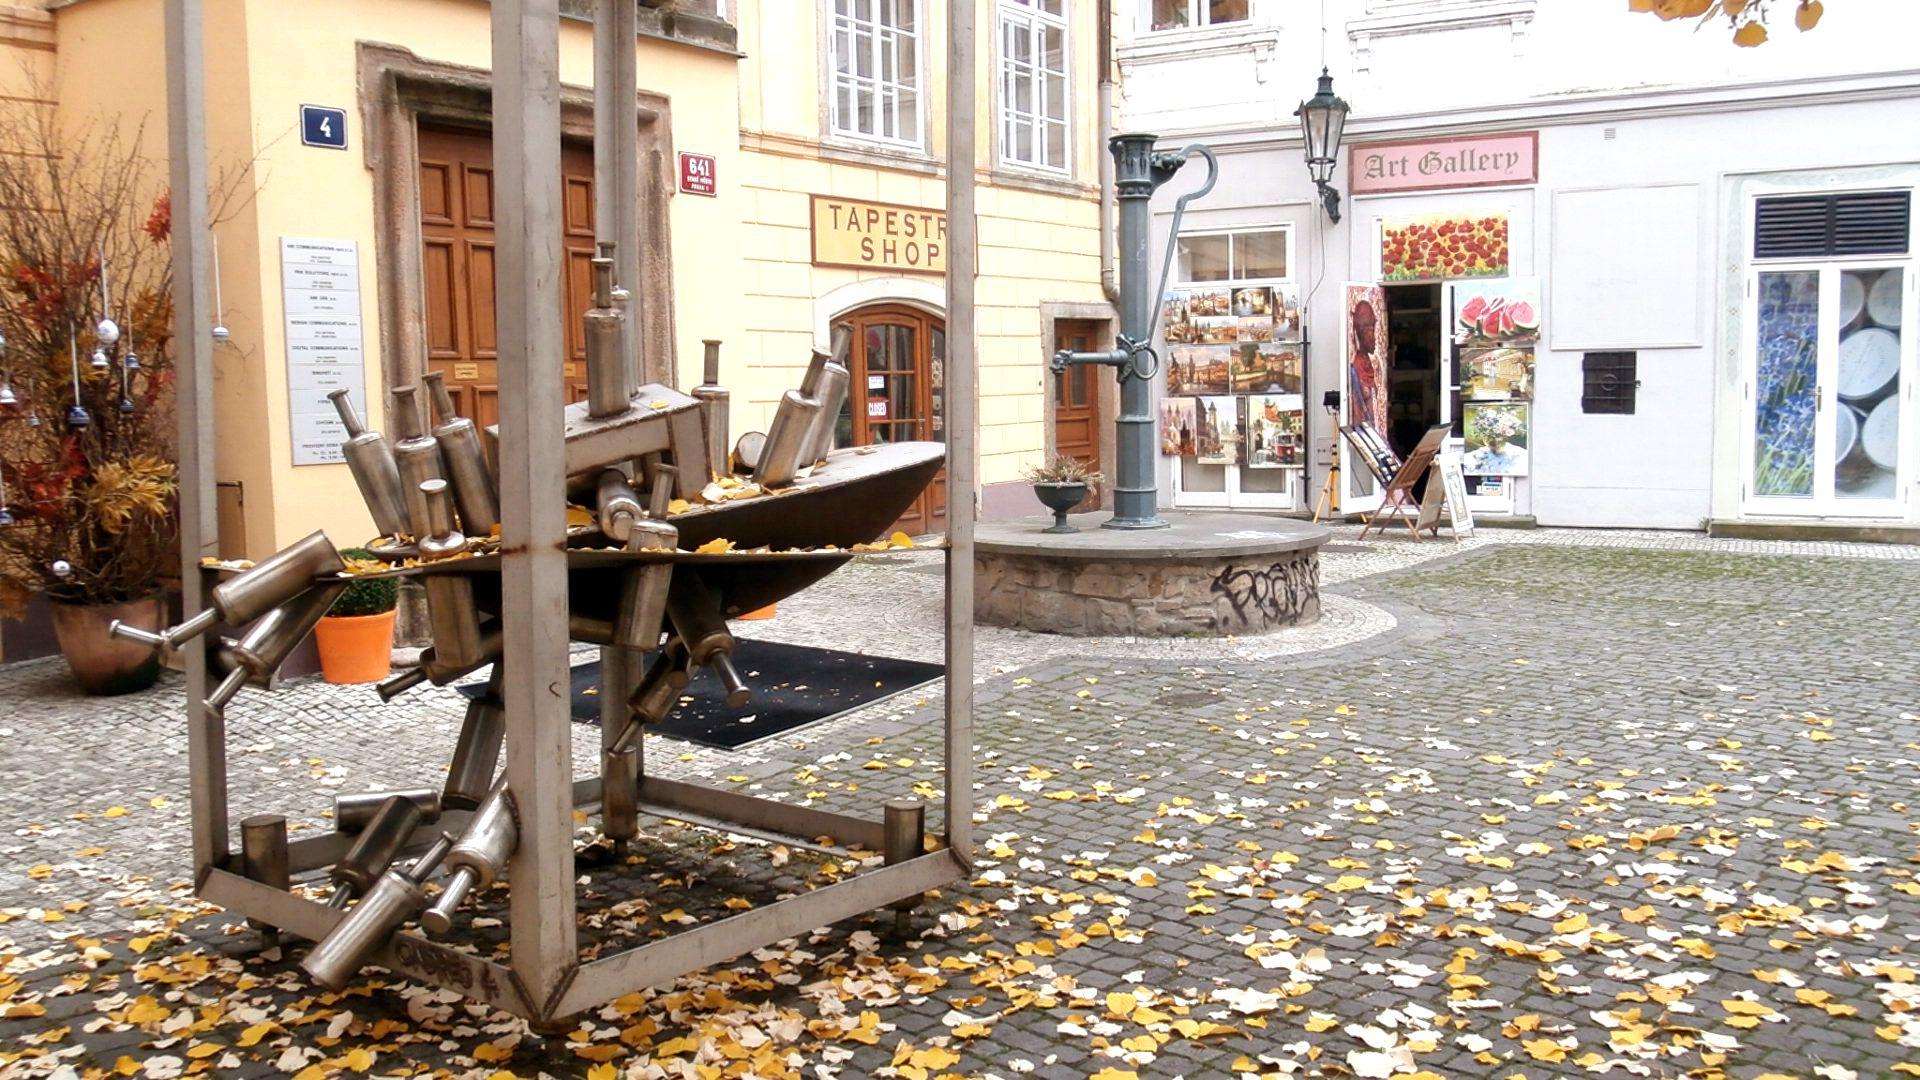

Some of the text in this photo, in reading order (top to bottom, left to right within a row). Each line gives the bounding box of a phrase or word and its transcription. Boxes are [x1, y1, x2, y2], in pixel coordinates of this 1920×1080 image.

[320, 116, 331, 138] 4
[689, 159, 709, 176] 641
[1364, 148, 1519, 180] Art Gallery
[827, 204, 946, 240] TAPESTR
[861, 236, 940, 267] SHOP
[868, 402, 887, 416] CLOSED
